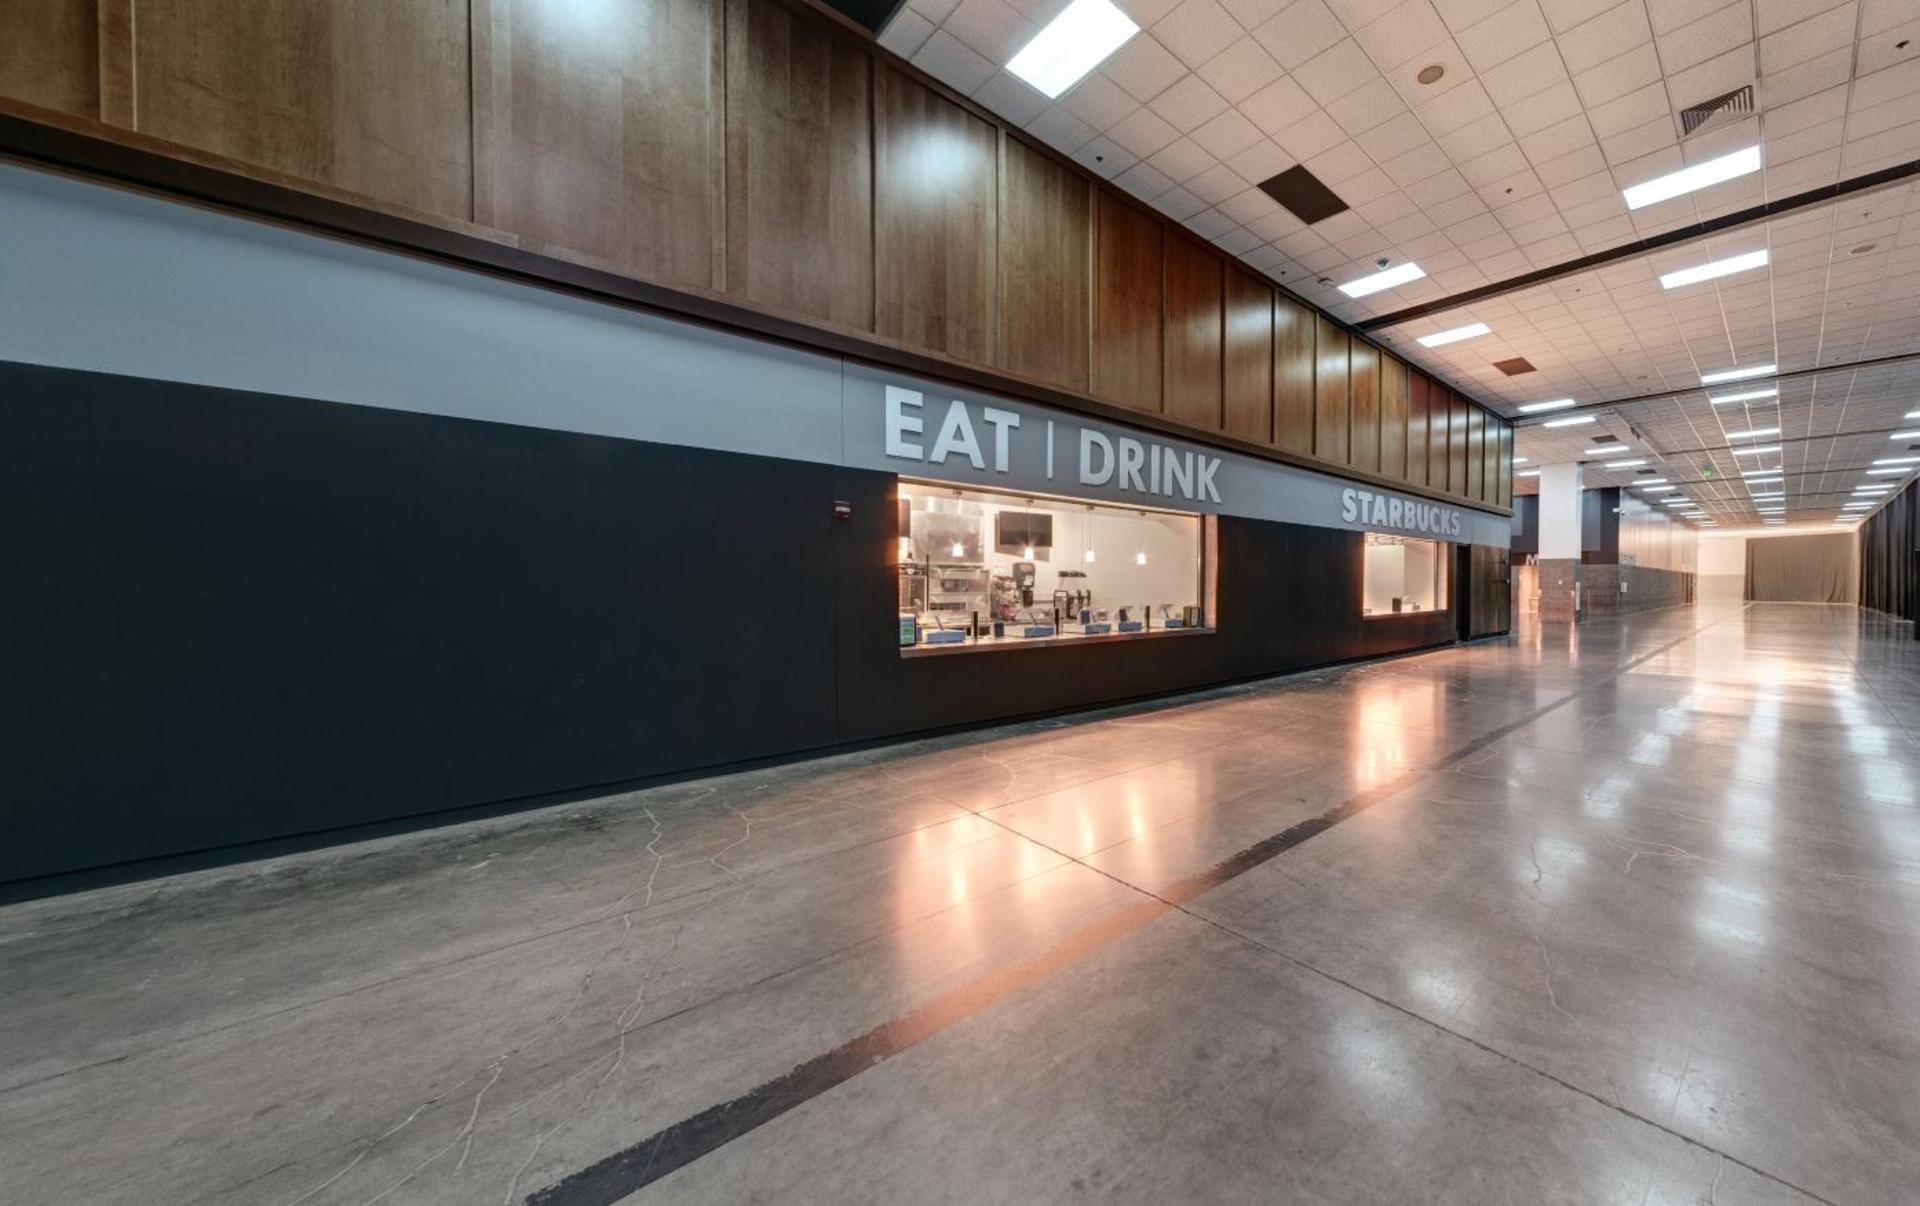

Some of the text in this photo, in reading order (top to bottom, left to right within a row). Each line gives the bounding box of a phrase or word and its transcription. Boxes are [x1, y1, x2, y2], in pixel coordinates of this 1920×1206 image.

[885, 385, 1020, 473] EAT
[1079, 427, 1222, 504] DRINK
[1342, 488, 1460, 536] STARBUCKS
